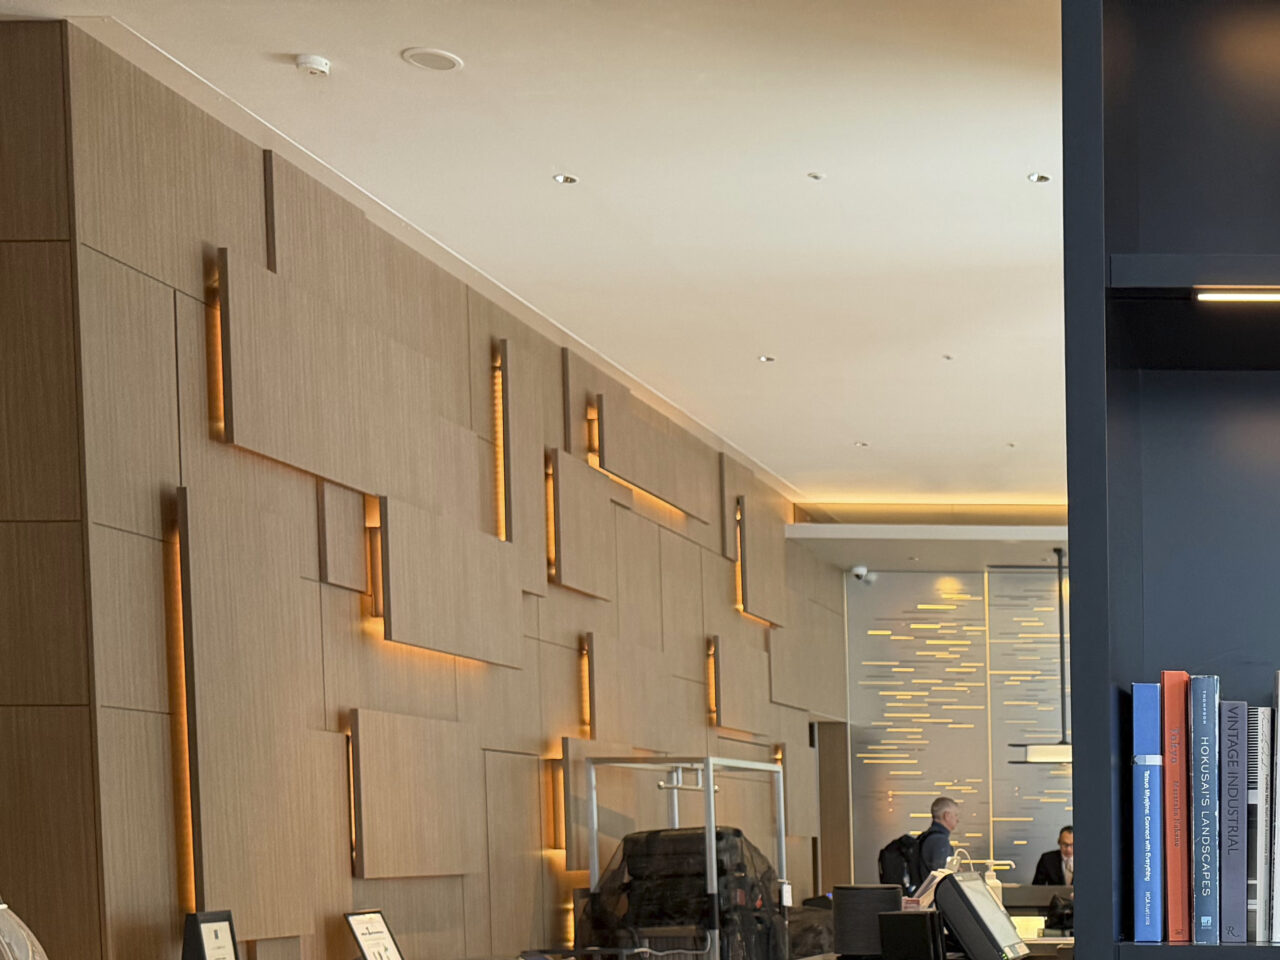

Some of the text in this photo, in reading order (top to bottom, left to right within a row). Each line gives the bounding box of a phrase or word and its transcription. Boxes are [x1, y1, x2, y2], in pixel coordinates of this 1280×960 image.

[1200, 737, 1211, 896] HOKUSAI'S LANDSCAPES
[1226, 706, 1240, 855] VINTAGE INDUSTRIAL
[1144, 852, 1152, 882] Everything
